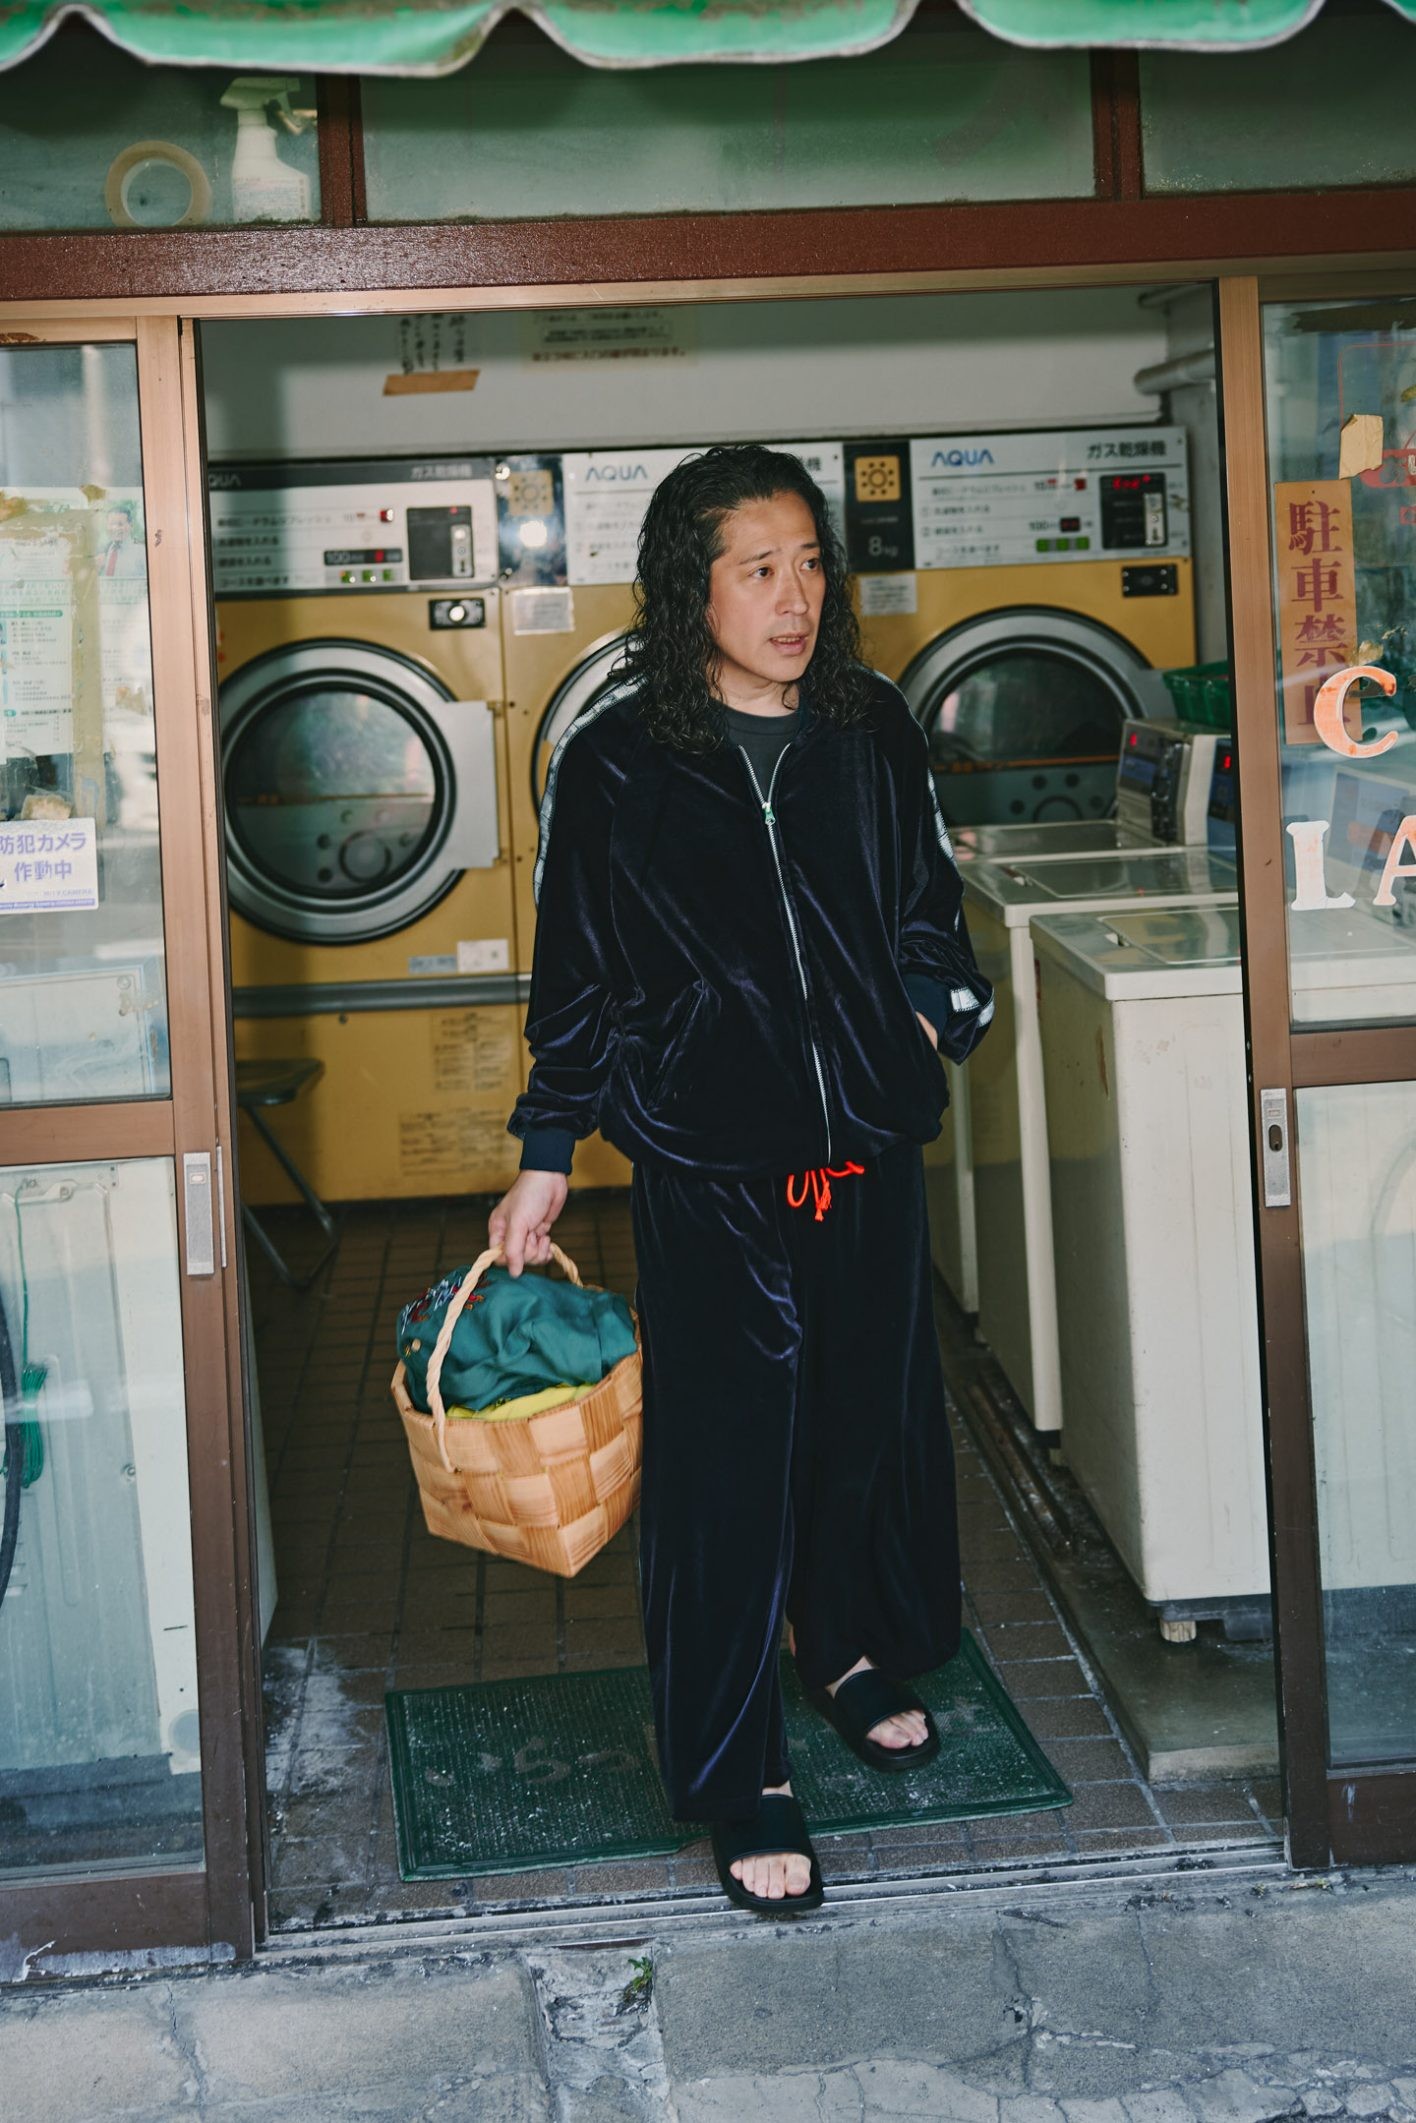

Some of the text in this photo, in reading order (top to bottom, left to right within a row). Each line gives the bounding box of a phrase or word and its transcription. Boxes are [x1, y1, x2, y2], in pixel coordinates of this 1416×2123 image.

[930, 449, 994, 467] AQUA
[208, 473, 242, 487] QUA
[586, 464, 647, 482] AQUA
[1314, 665, 1397, 758] C
[0, 833, 87, 855] 防犯カメラ
[14, 859, 72, 881] 作動中
